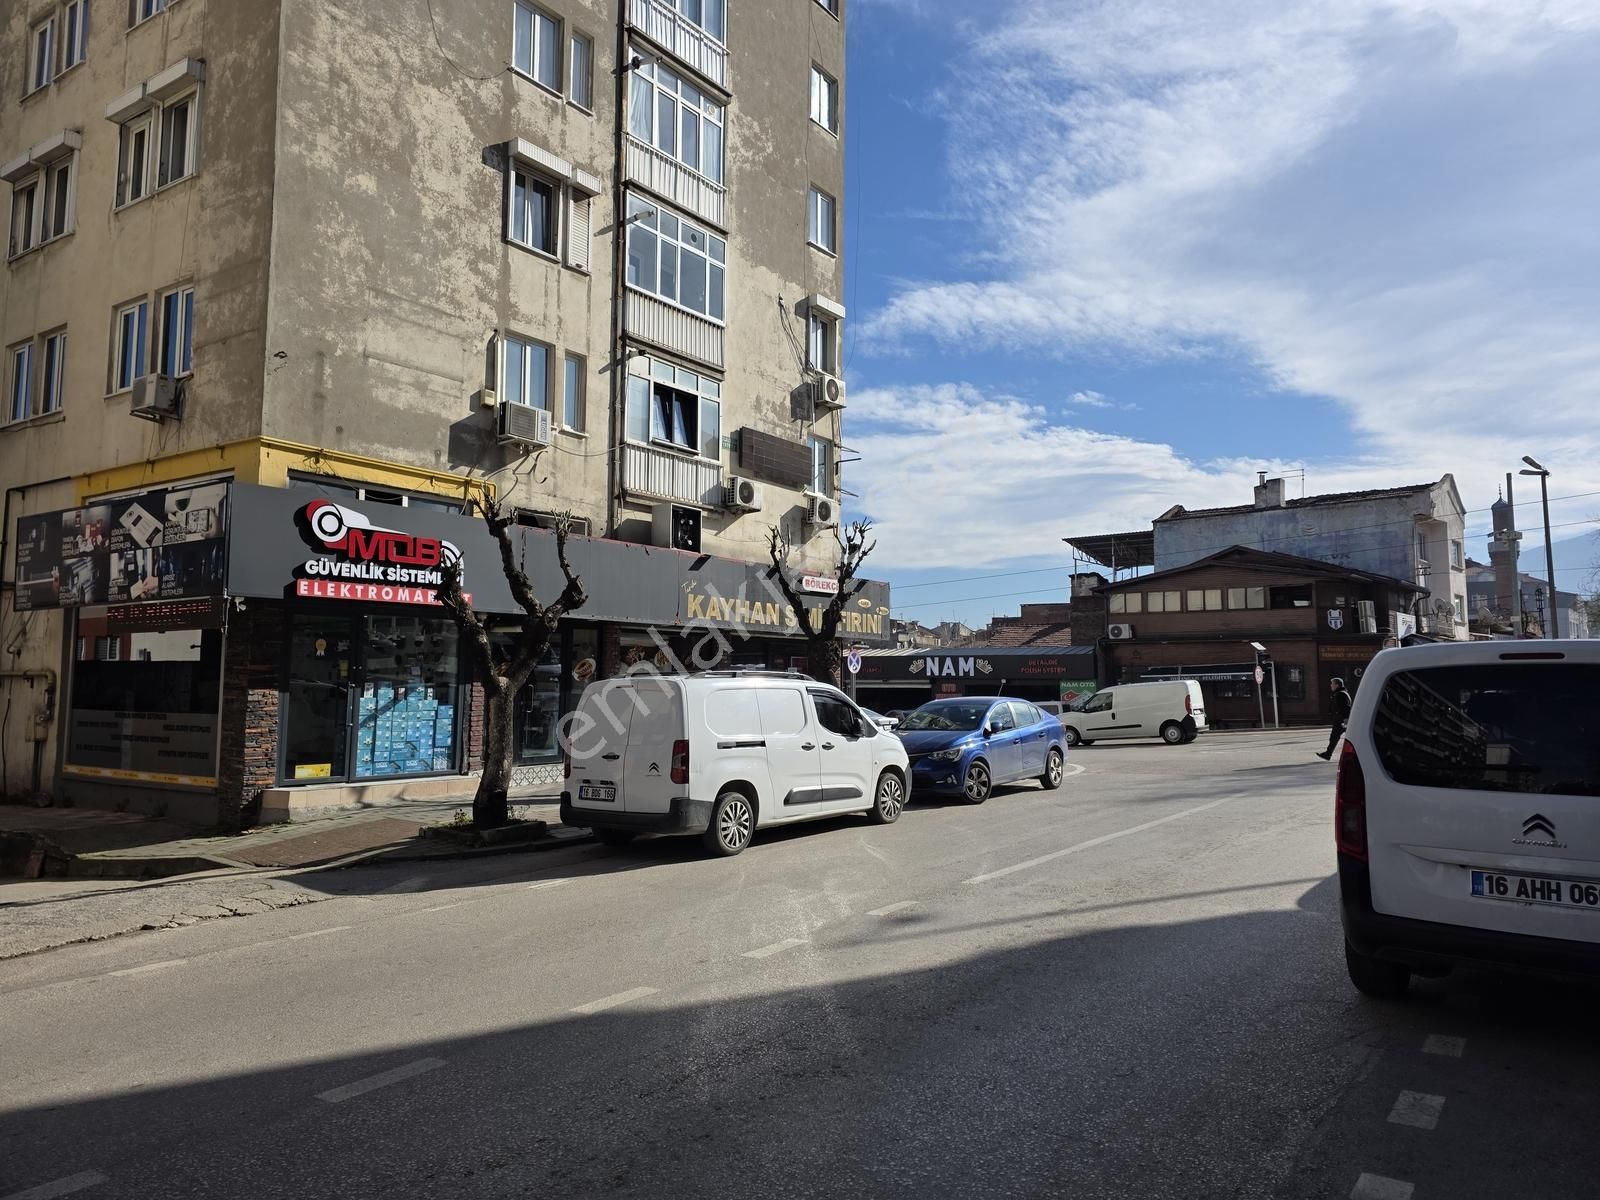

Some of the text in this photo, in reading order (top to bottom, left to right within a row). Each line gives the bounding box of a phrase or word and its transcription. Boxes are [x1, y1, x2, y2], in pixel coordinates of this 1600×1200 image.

[305, 557, 464, 587] GÜVENLİK SİSTEMLİ
[299, 581, 472, 605] ELEKTROMART
[687, 593, 780, 626] KAYHAN
[926, 656, 975, 677] NAM
[1485, 875, 1509, 896] 16
[1516, 878, 1562, 902] AHH
[1569, 883, 1600, 906] 06
